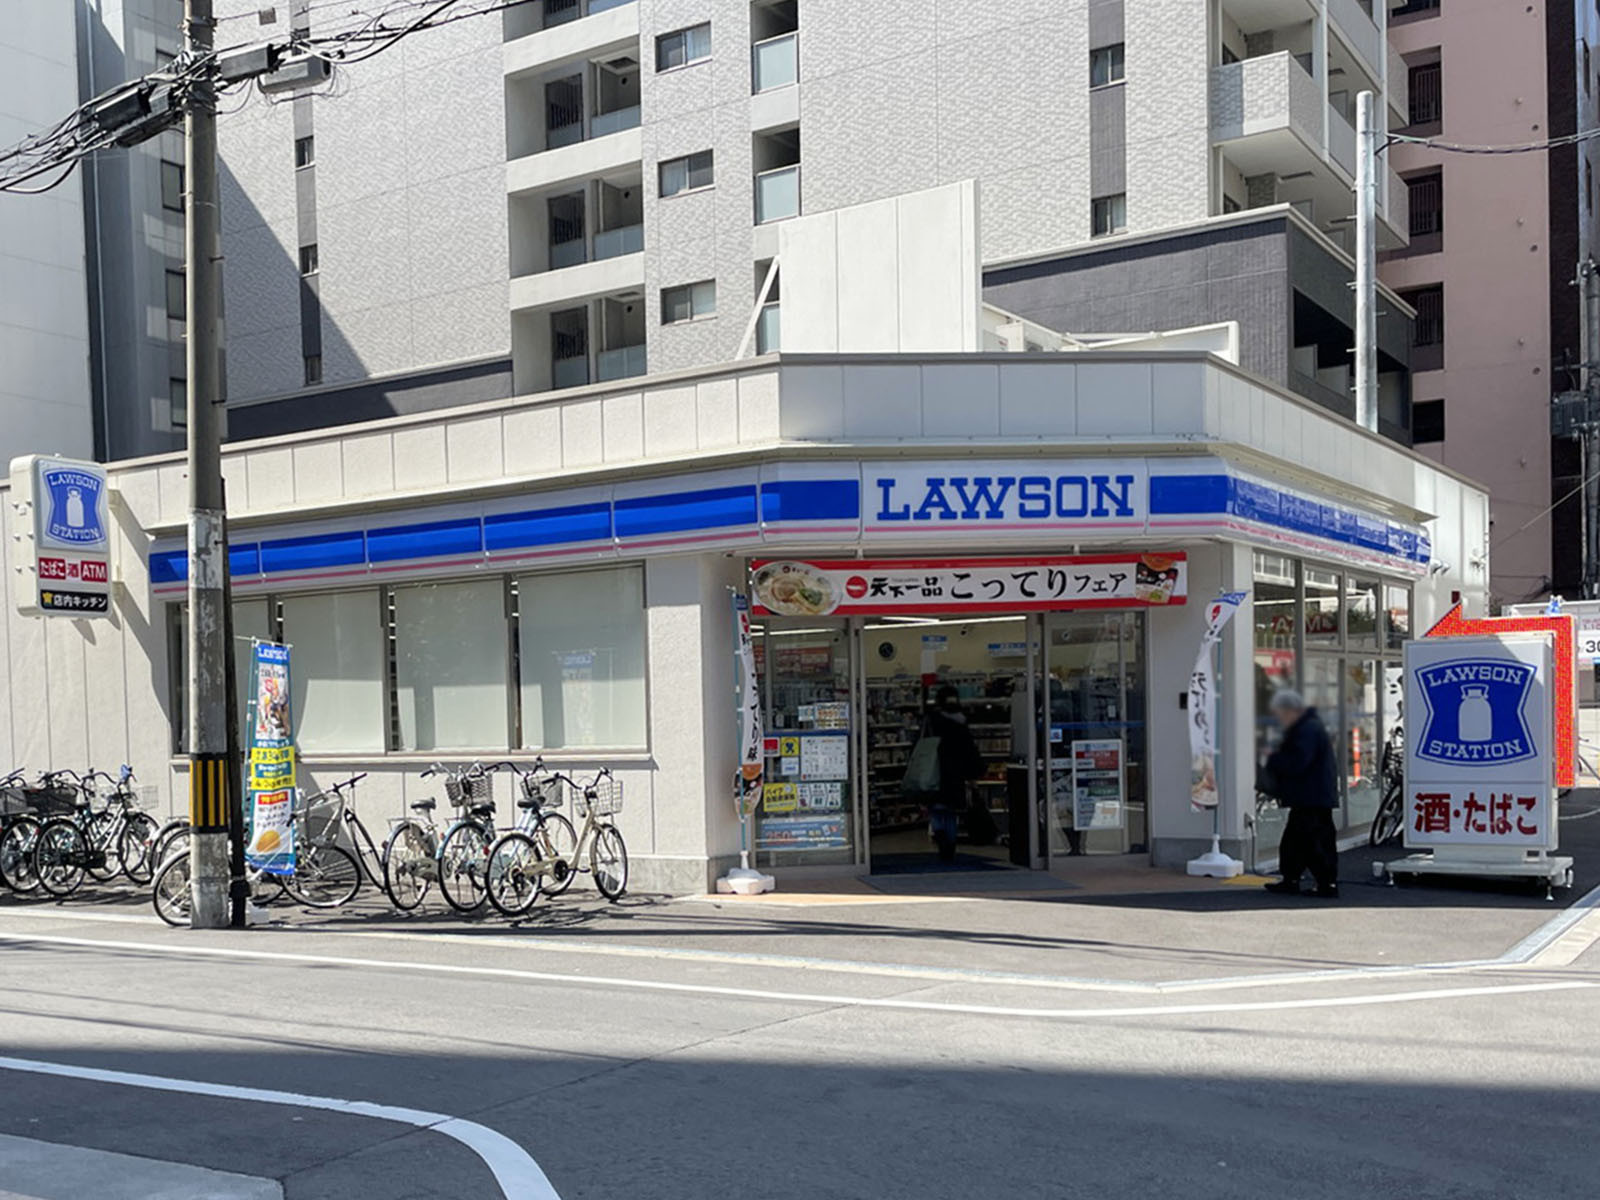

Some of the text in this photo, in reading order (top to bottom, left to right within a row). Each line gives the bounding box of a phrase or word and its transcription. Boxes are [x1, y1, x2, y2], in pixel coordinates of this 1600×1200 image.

[49, 473, 98, 491] LAWSON
[876, 475, 1135, 521] LAWSON
[52, 523, 100, 540] STATION
[82, 563, 107, 579] ATM
[870, 567, 1128, 600] 天下一品 こってりフェア
[53, 594, 107, 608] 店内キッチン
[1427, 665, 1524, 687] LAWSON
[1429, 739, 1522, 759] STATION
[1414, 792, 1538, 836] 酒・たばこ
